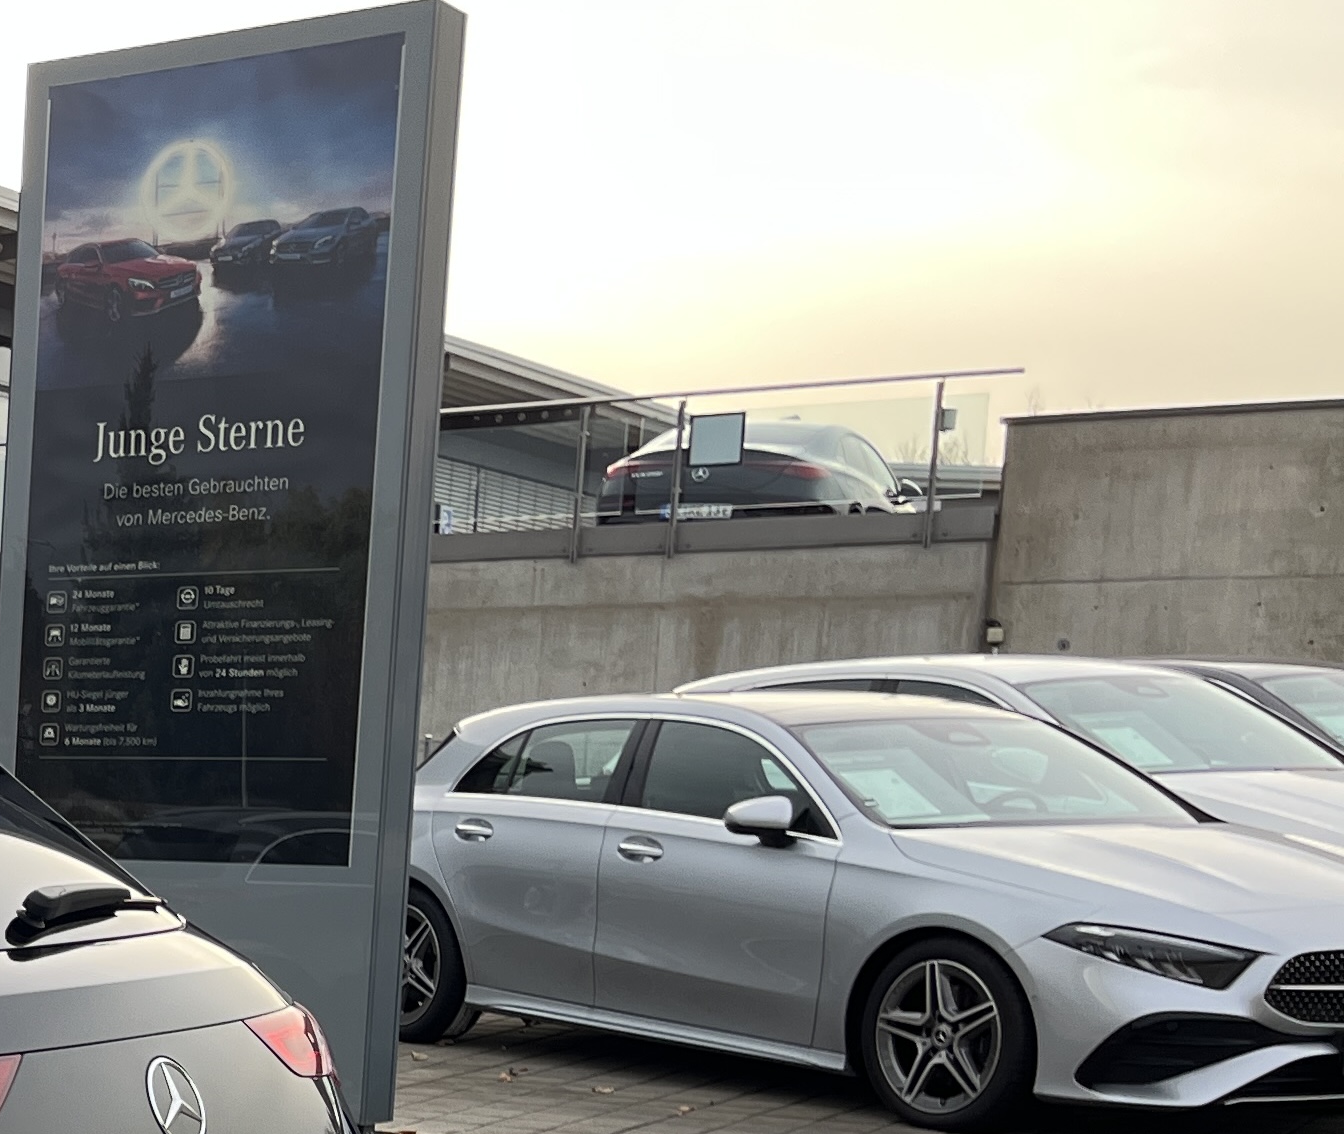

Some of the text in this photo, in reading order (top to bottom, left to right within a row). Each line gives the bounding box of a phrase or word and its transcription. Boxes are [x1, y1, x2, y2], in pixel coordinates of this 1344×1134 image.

[93, 413, 305, 466] Junge Sterne
[103, 475, 289, 500] Die besten Gebrauchten
[116, 504, 271, 527] von Mercedes-Benz.
[48, 564, 65, 574] Ihre
[66, 563, 98, 573] Vorteile
[99, 562, 113, 572] auf
[113, 562, 136, 571] einen
[72, 590, 115, 600] 24 Monate
[204, 585, 236, 597] 10 Tage
[70, 624, 111, 633] 12 Monate
[201, 634, 217, 644] und
[200, 654, 242, 664] Probefahrt
[267, 653, 306, 663] innerhalb
[198, 667, 298, 679] von 24 Stunden möglich
[78, 704, 85, 713] 3
[86, 703, 116, 713] Monate
[197, 702, 271, 714] Fahrzeugs möglich
[64, 737, 70, 746] 6
[71, 736, 101, 746] Monate
